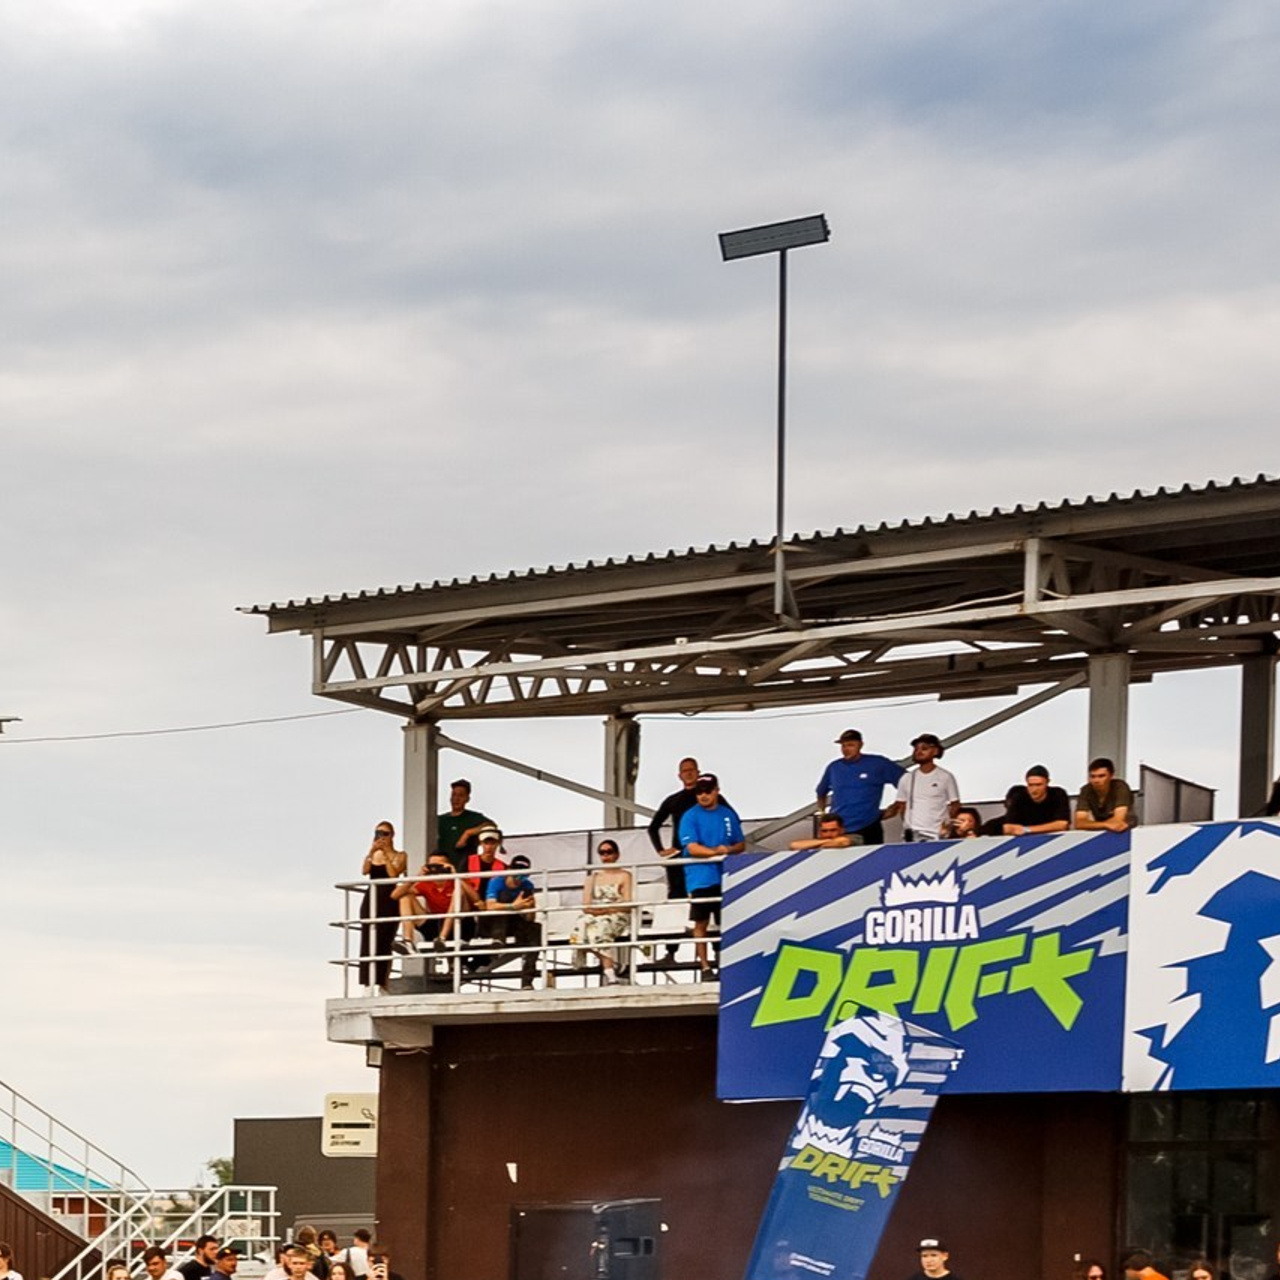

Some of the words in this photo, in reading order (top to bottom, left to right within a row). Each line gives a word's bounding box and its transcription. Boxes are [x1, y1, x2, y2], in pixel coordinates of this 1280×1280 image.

[866, 906, 979, 944] GORILLA
[750, 932, 1095, 1032] DRIFT
[790, 1144, 900, 1198] DRIFT
